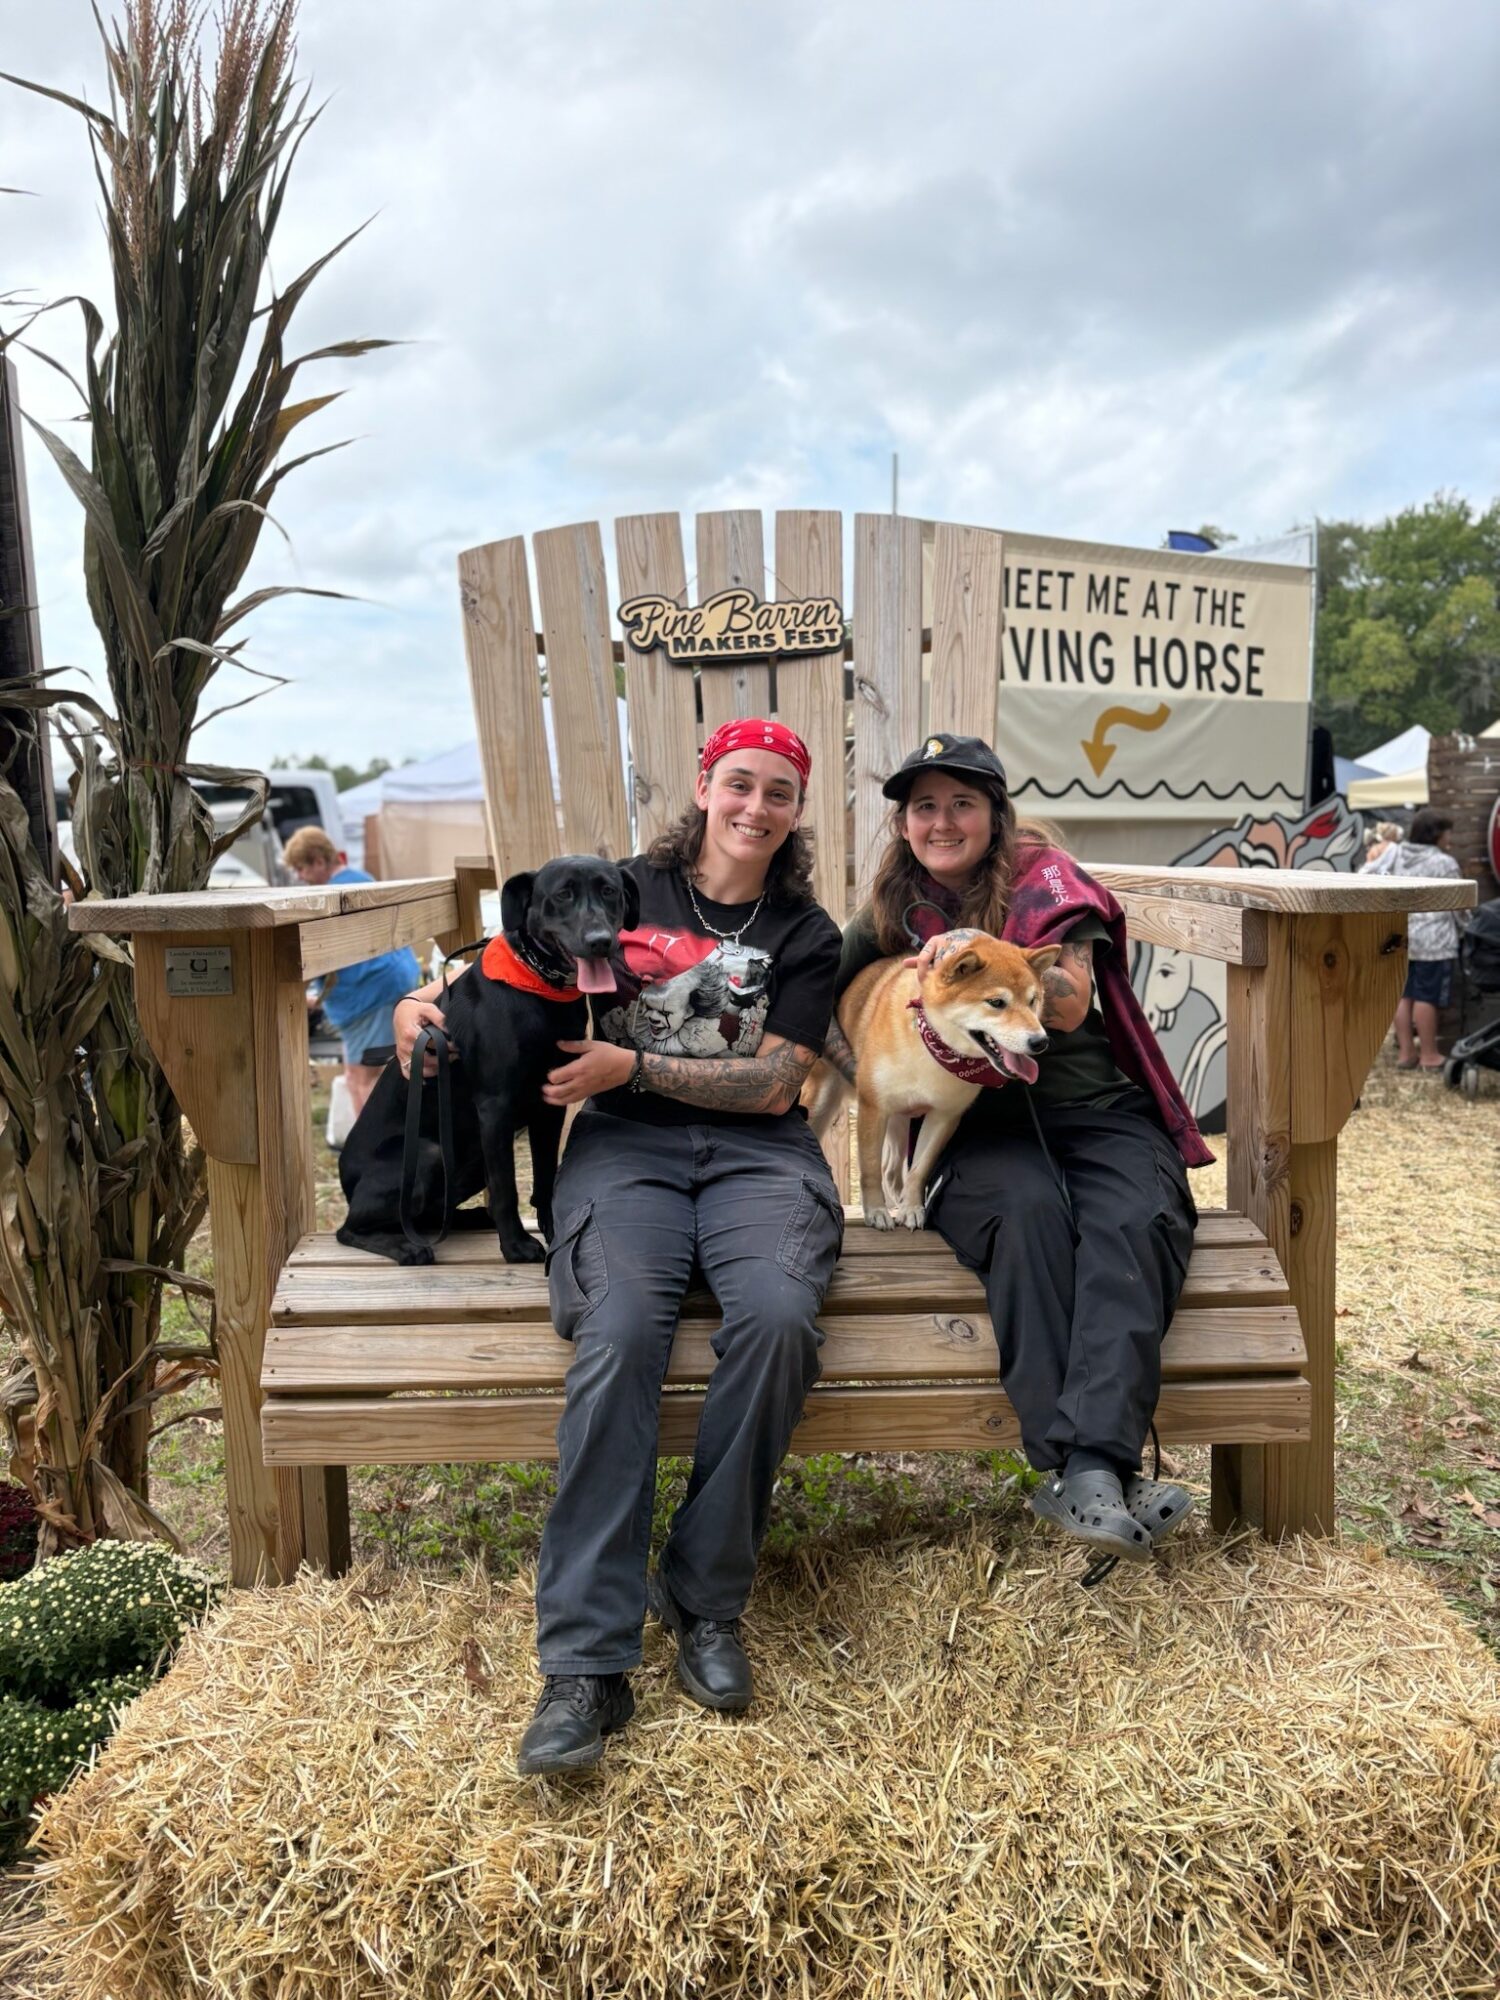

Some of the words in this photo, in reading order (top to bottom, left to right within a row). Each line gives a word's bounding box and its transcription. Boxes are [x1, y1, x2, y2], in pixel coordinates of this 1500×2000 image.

[625, 601, 705, 642] Pine
[708, 594, 836, 635] Barren
[1004, 567, 1075, 611] EET
[1087, 573, 1130, 616] ME
[1142, 580, 1181, 621] AT
[1193, 585, 1246, 629] THE
[673, 633, 776, 653] MAKERS
[784, 628, 838, 646] FEST
[1134, 635, 1264, 696] HORSE
[648, 932, 686, 957] IT
